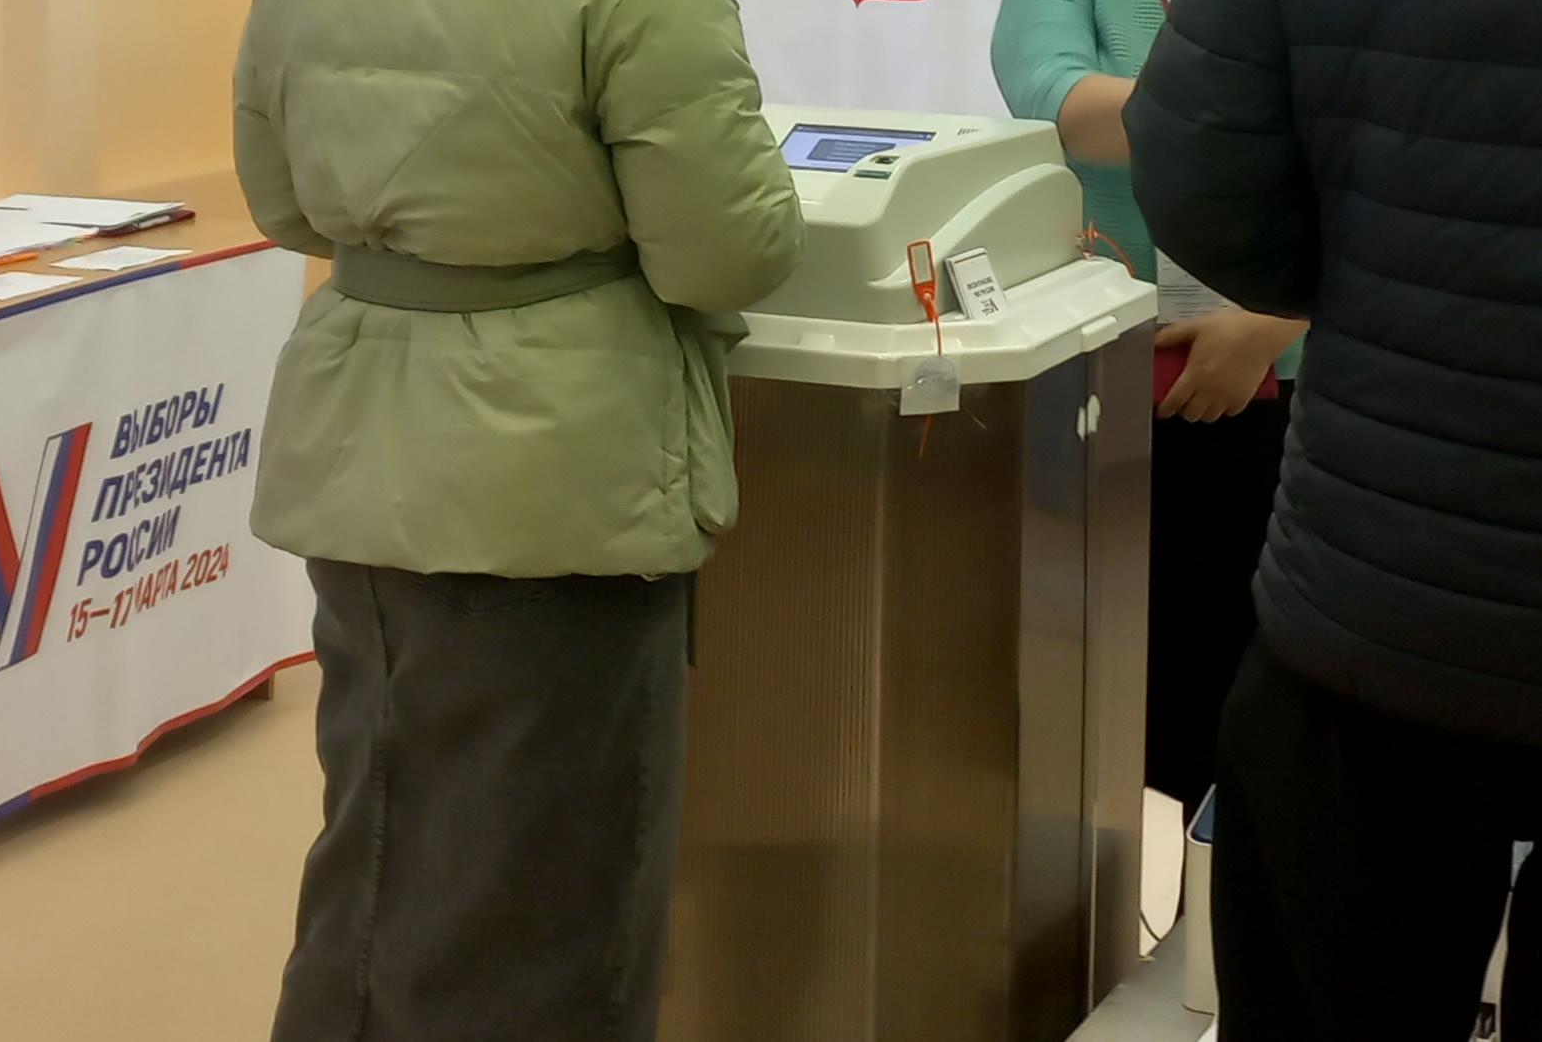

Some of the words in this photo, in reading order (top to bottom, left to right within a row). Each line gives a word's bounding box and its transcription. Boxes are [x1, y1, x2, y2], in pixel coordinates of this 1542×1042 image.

[110, 383, 225, 460] ВЫБОРЫ
[91, 428, 252, 523] ПРЕЗИДЕНТА
[76, 505, 182, 587] РОССИИ
[180, 543, 230, 591] 2024
